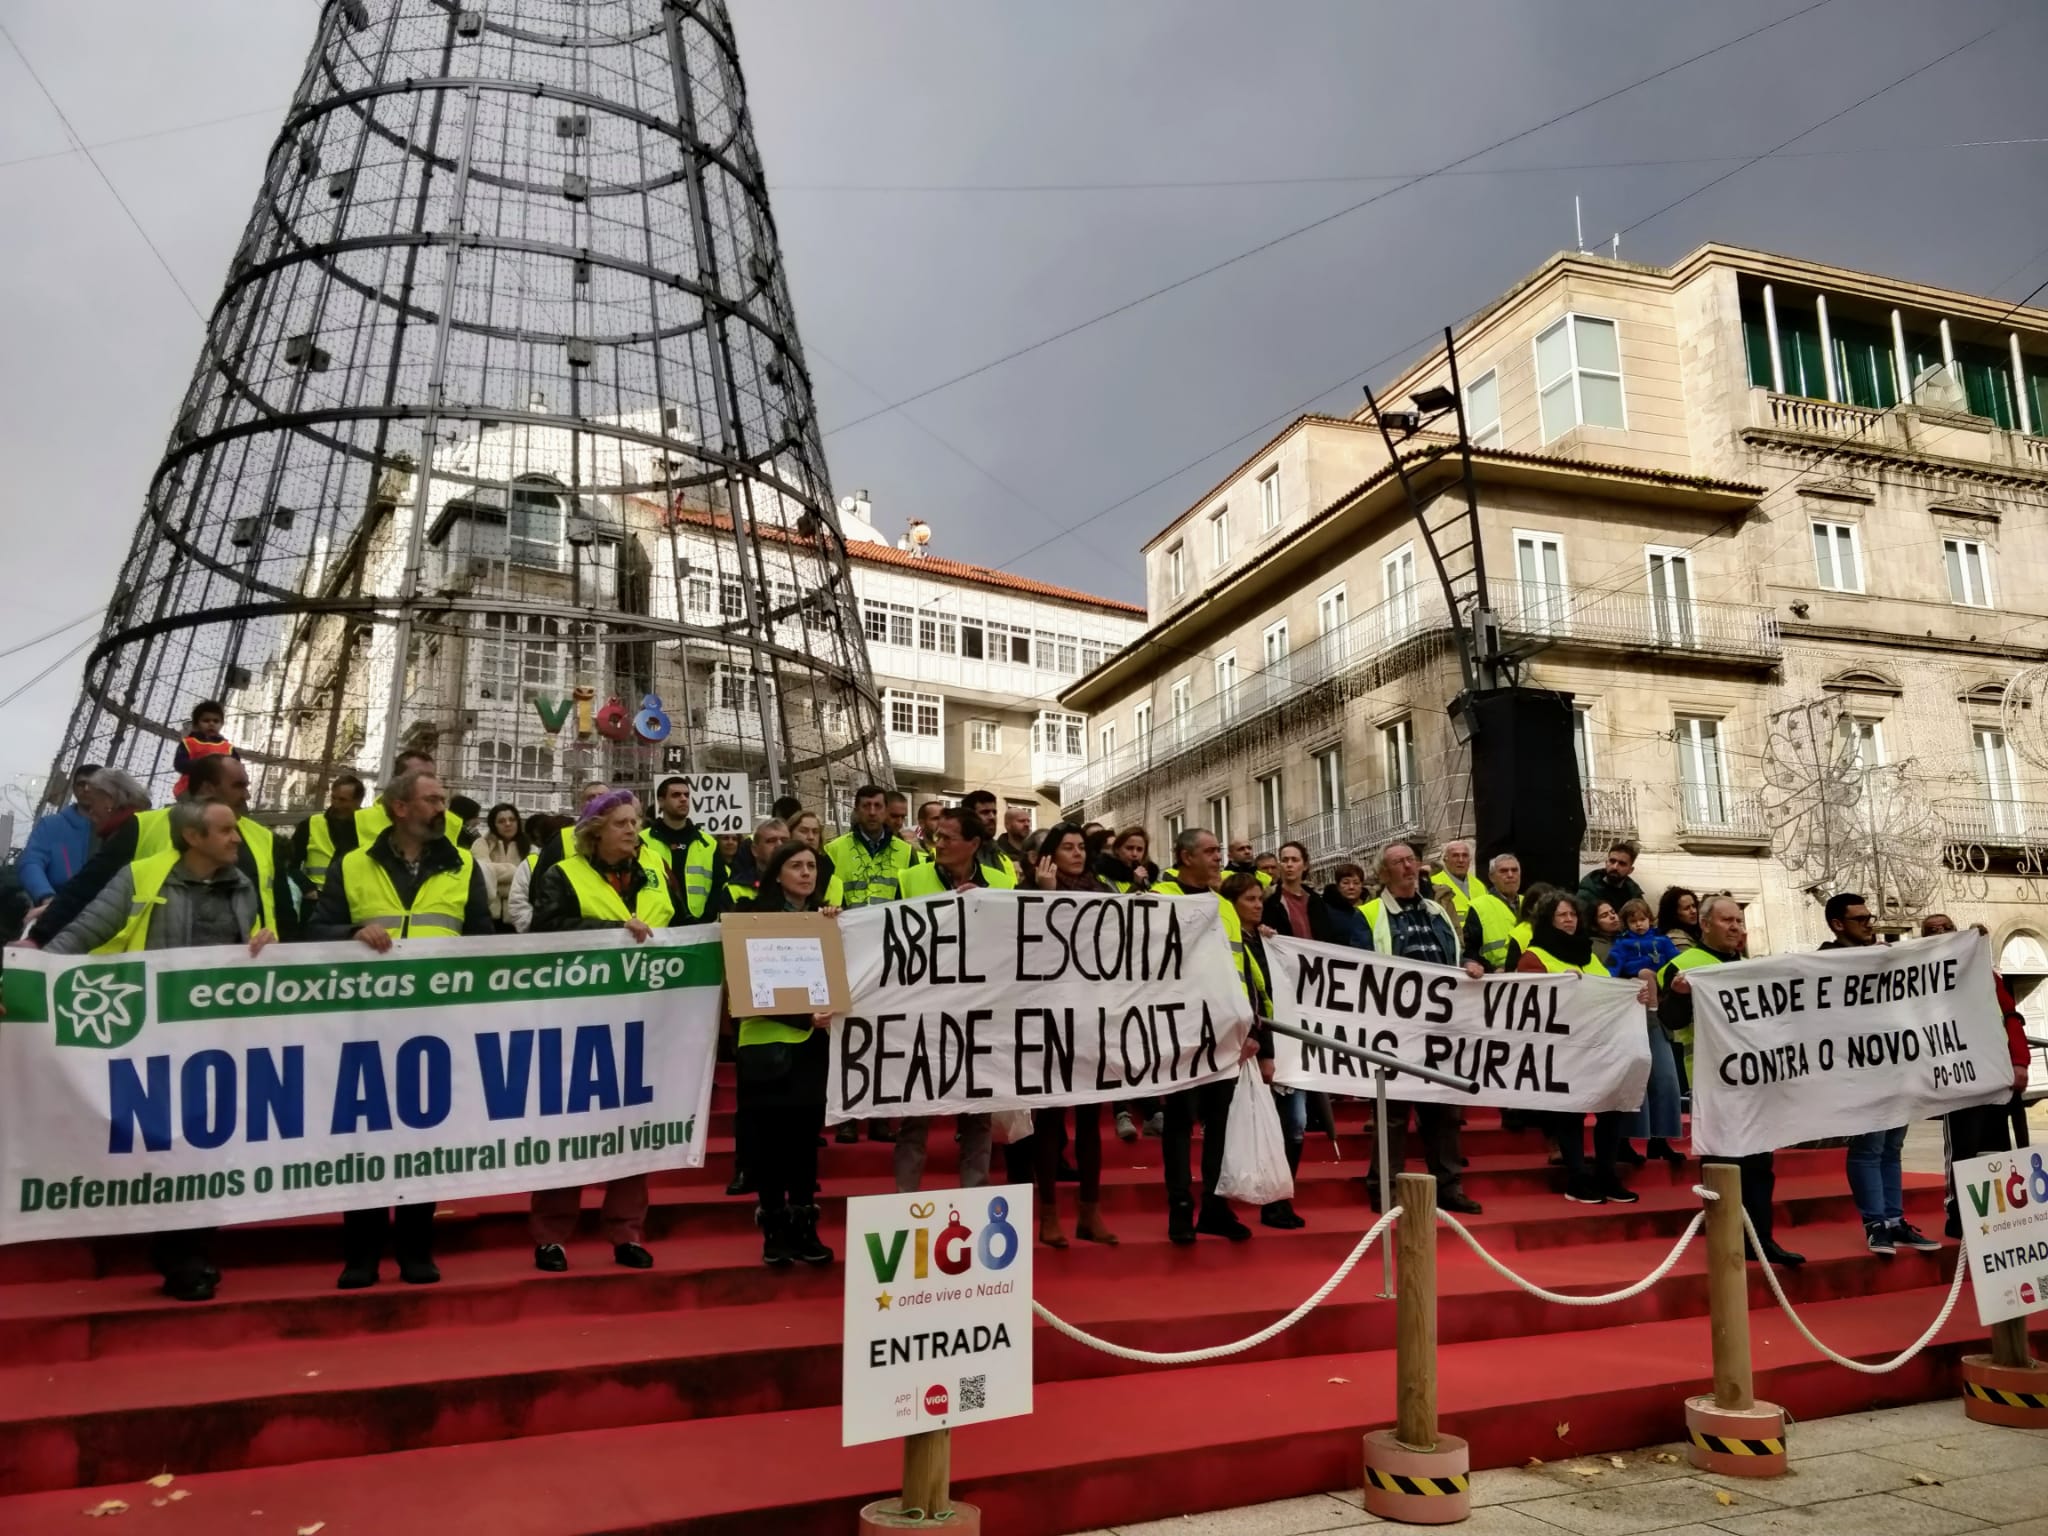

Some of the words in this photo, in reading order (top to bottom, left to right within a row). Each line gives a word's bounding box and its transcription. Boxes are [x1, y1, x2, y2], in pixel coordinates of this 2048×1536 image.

[685, 775, 730, 792] NON
[691, 794, 743, 813] VIAL
[696, 814, 743, 832] -010
[880, 897, 986, 987] ABEL
[1016, 895, 1183, 982] ESCOITA
[189, 970, 416, 1008] ecoloxistas
[429, 966, 474, 995] en
[488, 955, 611, 990] acción
[621, 950, 686, 989] Vigo
[1296, 954, 1458, 1024] MENOS
[1483, 981, 1570, 1035] VIAL
[1718, 978, 1805, 1024] BEADE
[1817, 976, 1833, 1009] E
[1844, 958, 1957, 1008] BEMBRIVE
[841, 1008, 994, 1110] BEADE
[1014, 1007, 1075, 1095] EN
[1096, 999, 1219, 1090] LOITA
[1301, 1019, 1399, 1081] MAIS
[1423, 1034, 1570, 1094] RURAL
[1719, 1043, 1809, 1086] CONTRA
[1819, 1038, 1834, 1071] O
[1847, 1029, 1919, 1069] NOVO
[1923, 1020, 1967, 1058] VIAL
[1933, 1060, 1977, 1089] PO-010
[108, 1044, 304, 1154] NON
[330, 1035, 452, 1135] AO
[475, 1021, 654, 1121] VIAL
[20, 1169, 246, 1213] Defendamos
[254, 1164, 273, 1193] o
[282, 1151, 386, 1192] medio
[394, 1141, 506, 1180] natural
[514, 1133, 551, 1166] do
[558, 1124, 625, 1159] rural
[864, 1196, 1019, 1284] VIGO
[1993, 1220, 2012, 1233] onde
[2012, 1217, 2027, 1228] vive
[2034, 1211, 2048, 1222] Nad
[1982, 1240, 2048, 1274] ENTRAD
[898, 1290, 932, 1307] onde
[936, 1287, 962, 1302] vive
[964, 1288, 973, 1299] o
[977, 1279, 1014, 1298] Nadal
[869, 1322, 1012, 1369] ENTRADA
[895, 1394, 912, 1405] APP
[896, 1407, 912, 1417] info
